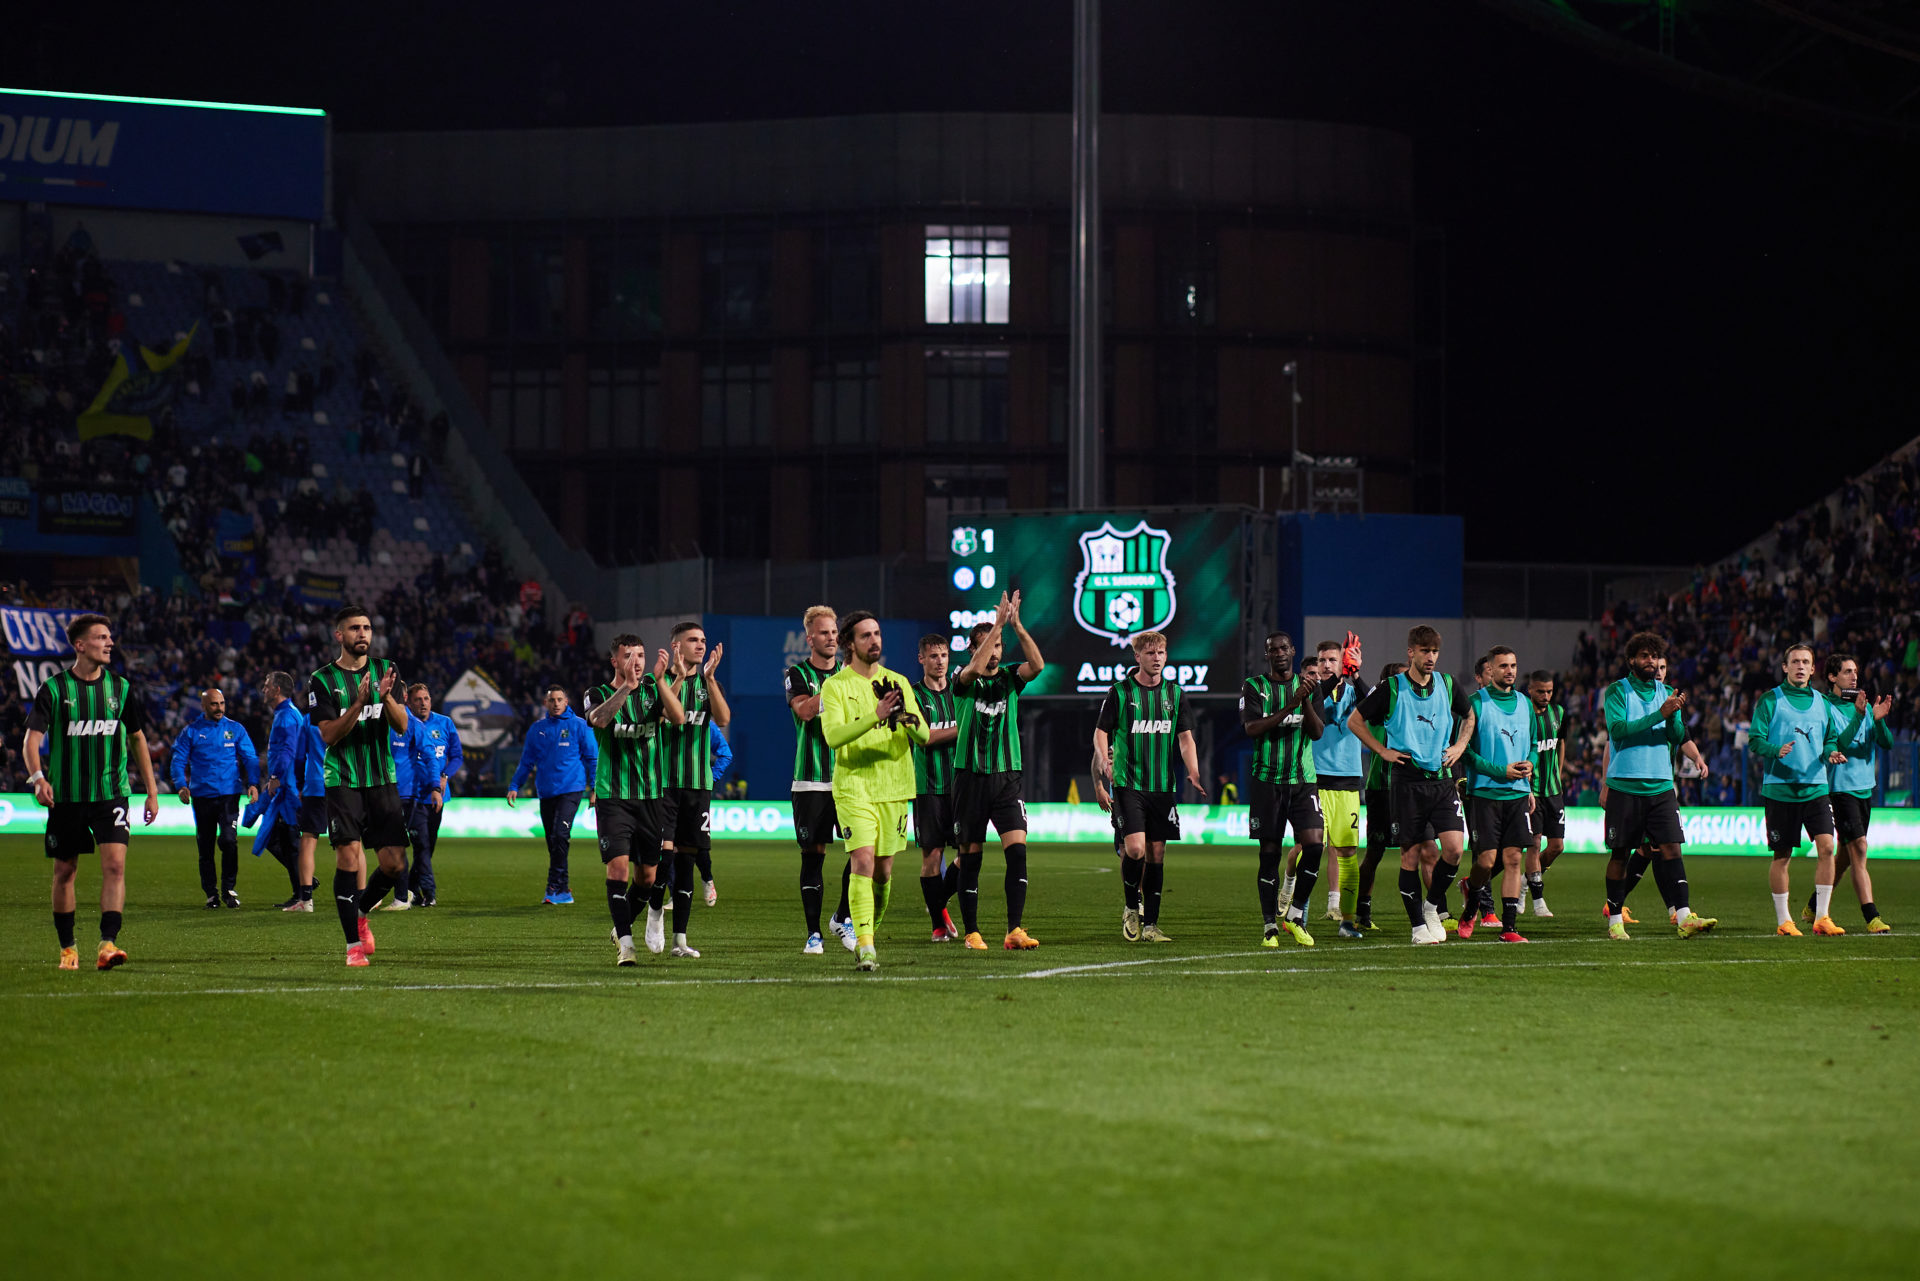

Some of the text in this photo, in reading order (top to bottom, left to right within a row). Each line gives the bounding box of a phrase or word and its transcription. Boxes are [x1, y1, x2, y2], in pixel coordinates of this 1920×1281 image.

[0, 114, 120, 167] DIUM
[981, 528, 994, 553] 1
[980, 565, 996, 589] 0
[67, 720, 118, 736] MAPEI
[1131, 720, 1172, 734] MAPEI
[113, 807, 130, 826] 2
